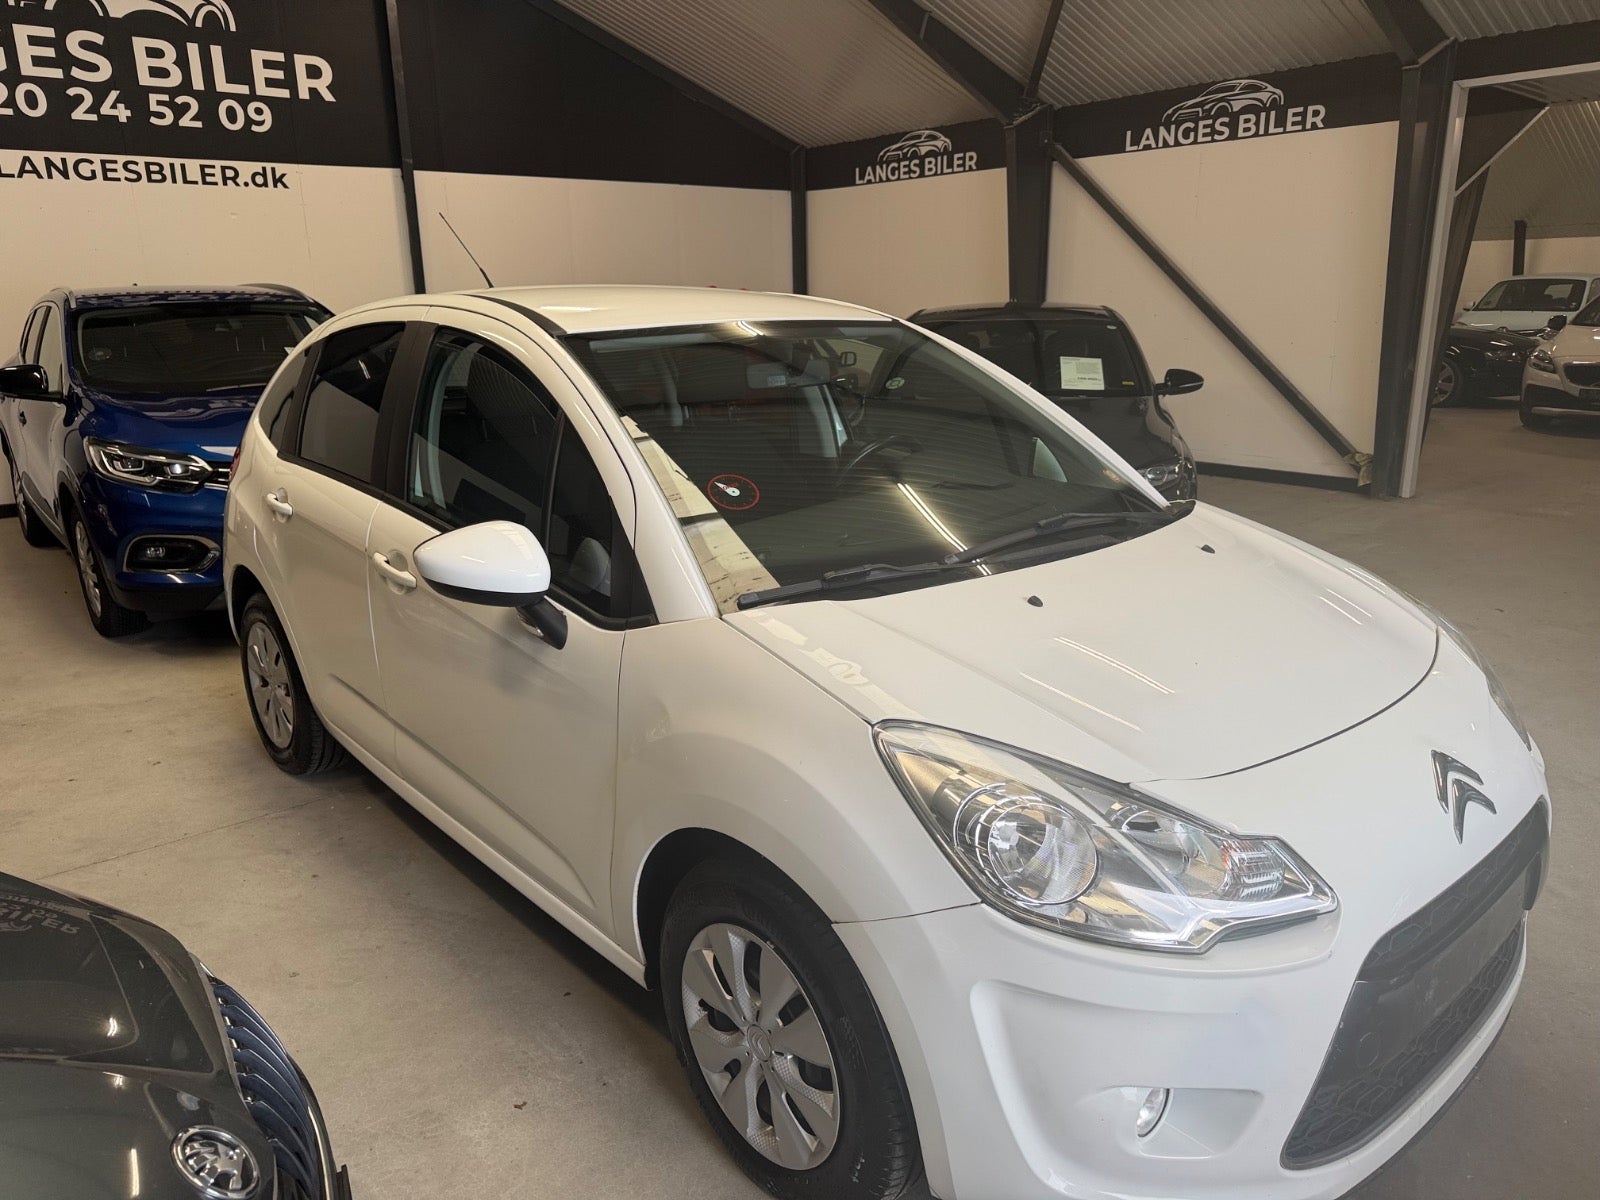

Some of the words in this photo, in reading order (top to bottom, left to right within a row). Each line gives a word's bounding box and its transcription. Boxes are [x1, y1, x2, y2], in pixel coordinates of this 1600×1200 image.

[0, 23, 113, 83] ES
[131, 36, 336, 102] BILER
[65, 86, 131, 122] 24
[148, 93, 203, 128] 52
[217, 99, 273, 133] 09
[1125, 117, 1230, 151] LANGES
[1237, 104, 1326, 138] BILER
[855, 159, 920, 185] LANGES
[924, 151, 977, 176] BILER
